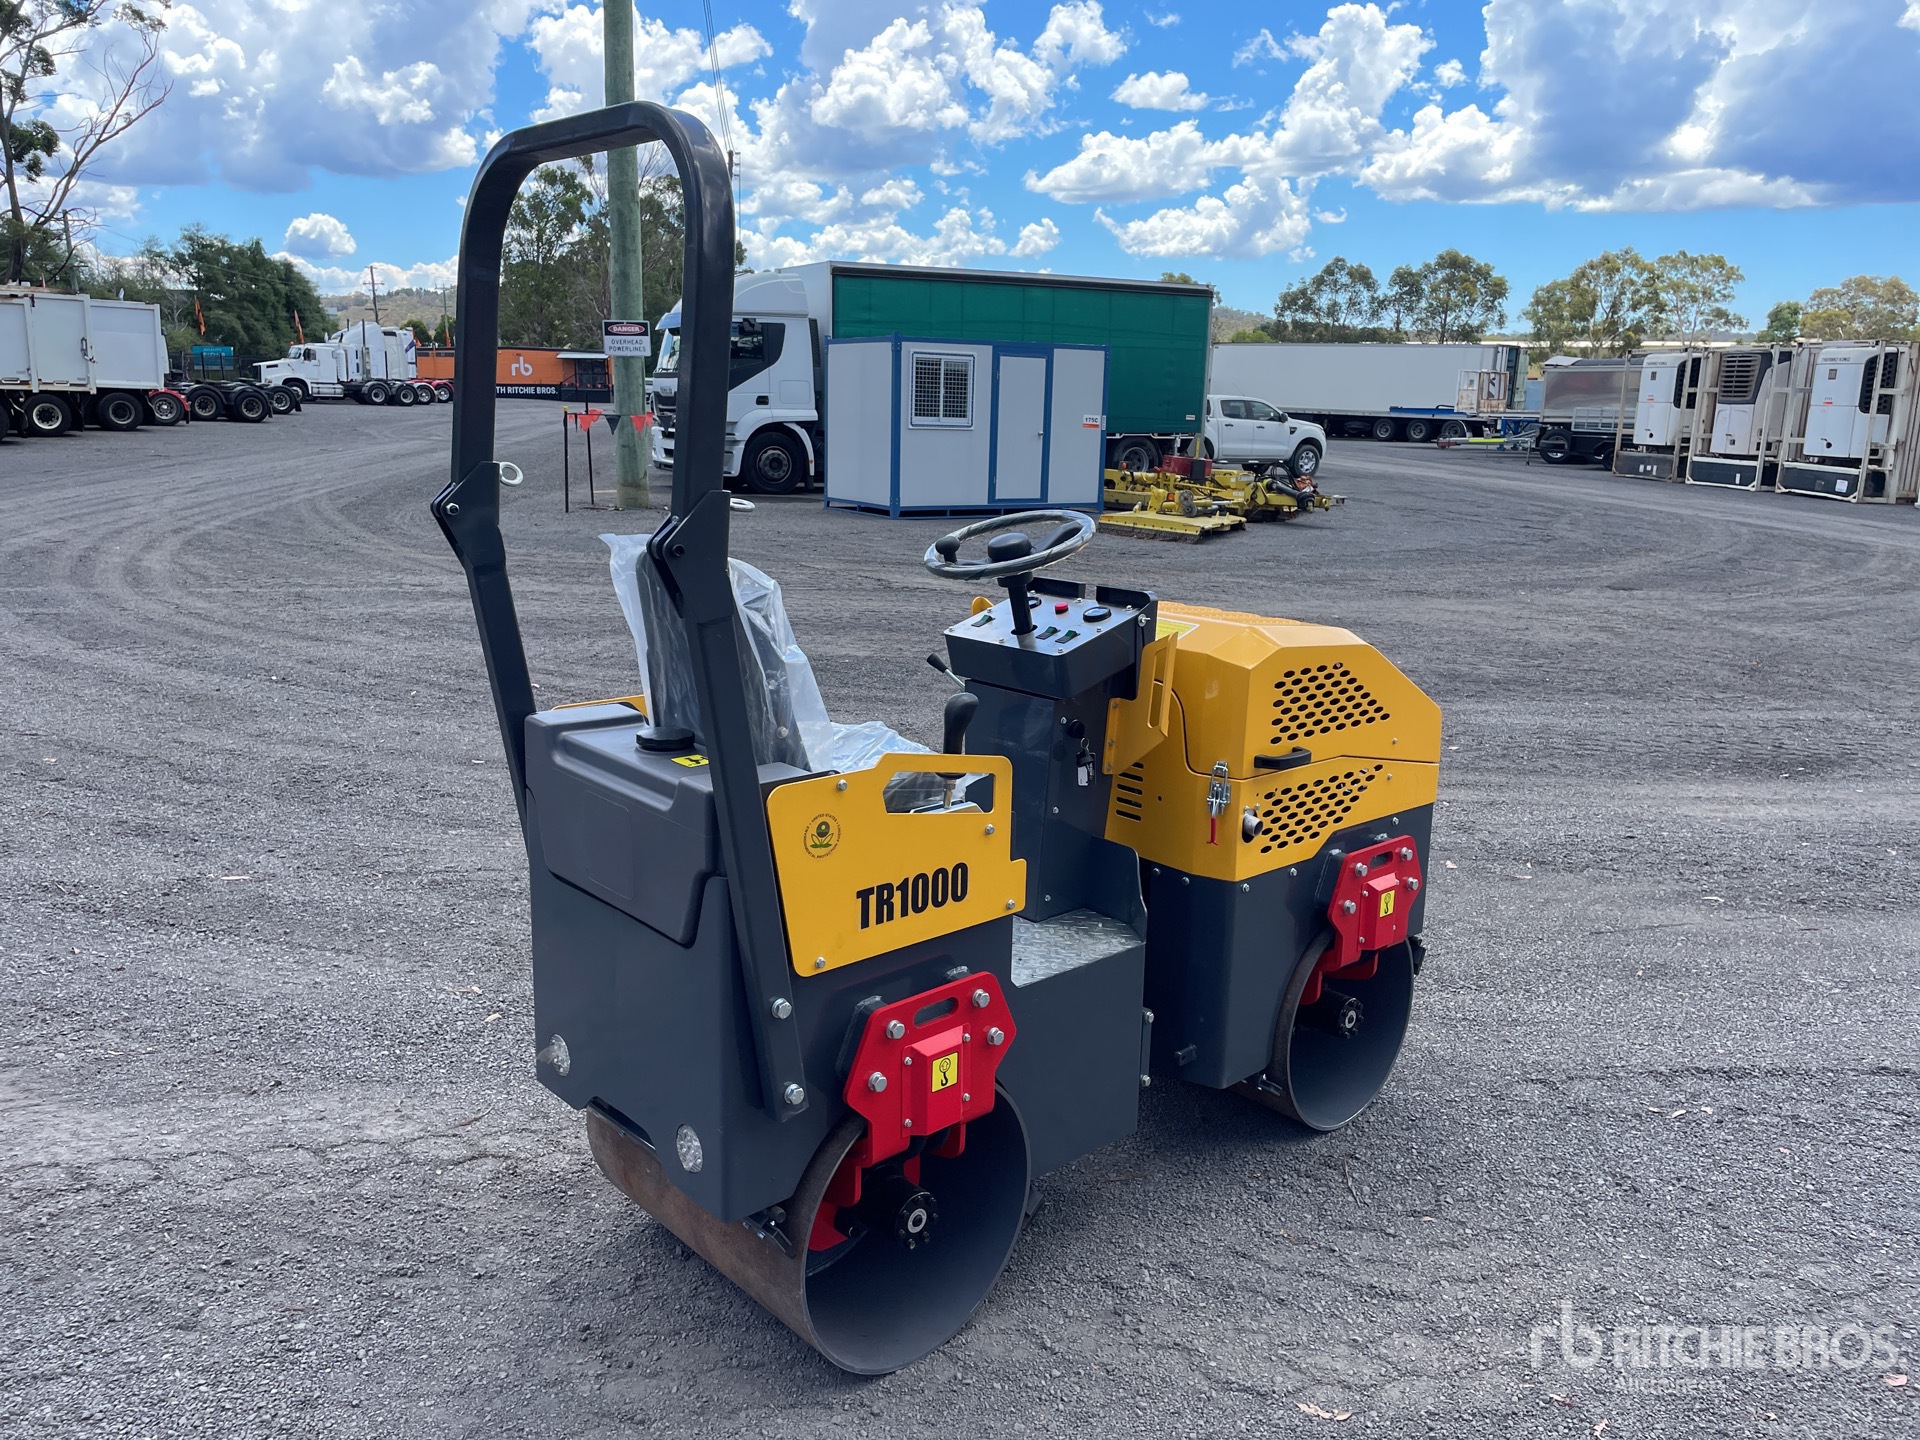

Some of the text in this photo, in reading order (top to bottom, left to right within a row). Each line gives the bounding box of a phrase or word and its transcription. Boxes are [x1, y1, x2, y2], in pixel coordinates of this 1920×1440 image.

[511, 356, 533, 376] rb
[496, 386, 506, 394] TH
[507, 386, 536, 394] RITCHIE
[856, 862, 969, 930] TR1000
